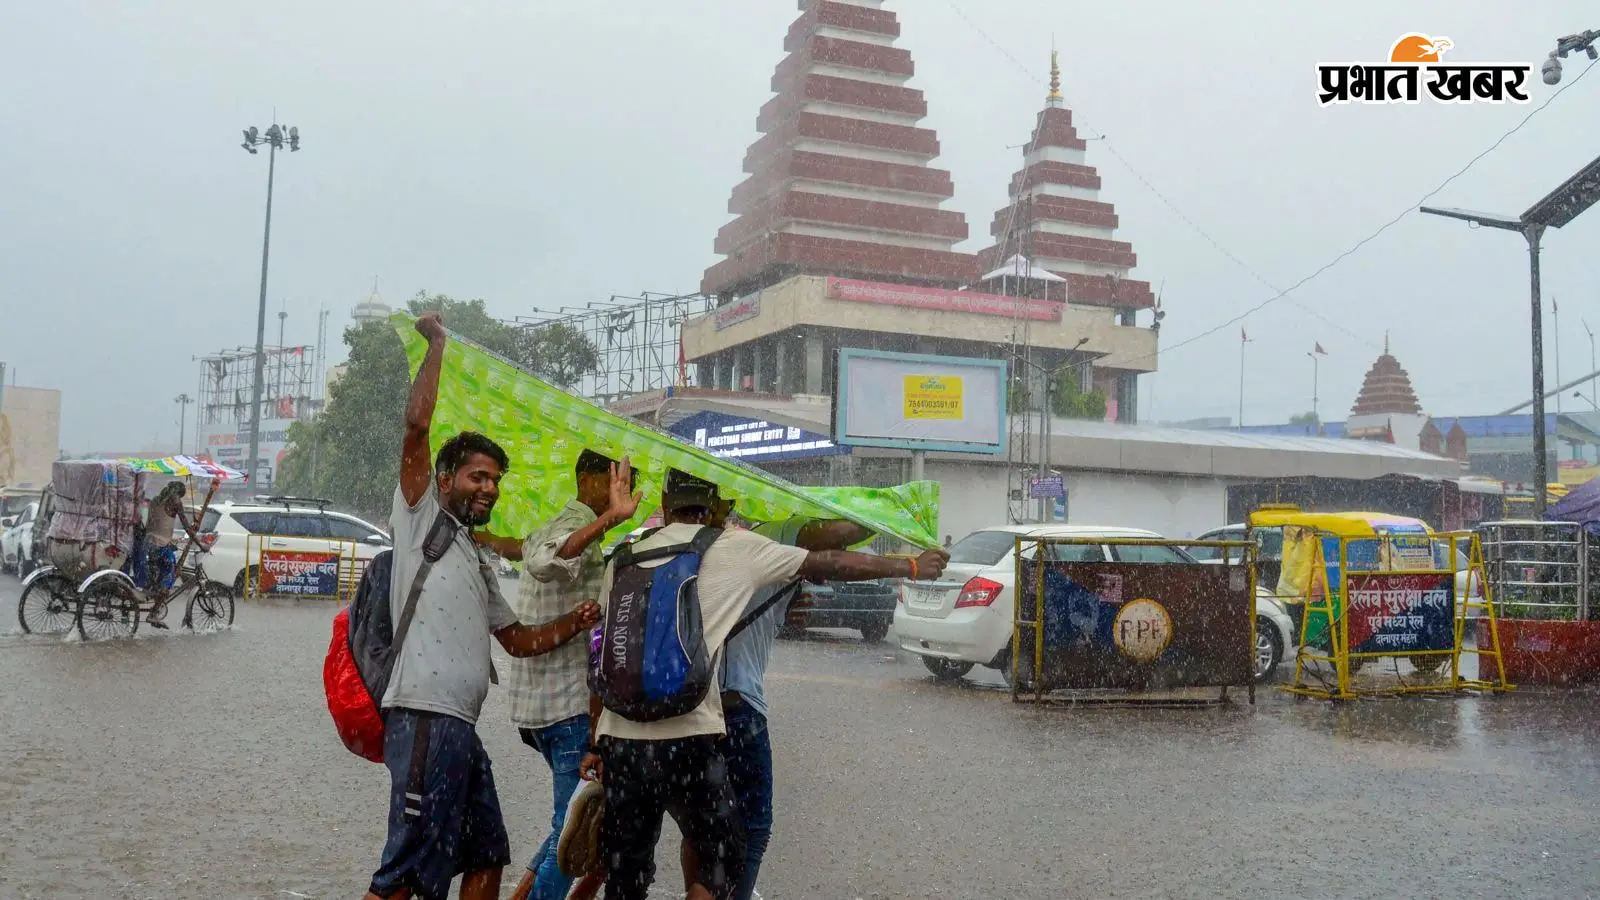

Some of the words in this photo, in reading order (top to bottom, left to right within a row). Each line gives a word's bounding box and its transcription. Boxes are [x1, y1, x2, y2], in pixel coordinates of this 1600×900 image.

[763, 428, 784, 441] ENTRY
[616, 591, 635, 623] STAR
[1347, 579, 1382, 610] रेलवे
[1383, 589, 1422, 614] सुरक्षा
[1423, 589, 1448, 610] बल
[612, 626, 628, 669] MOON
